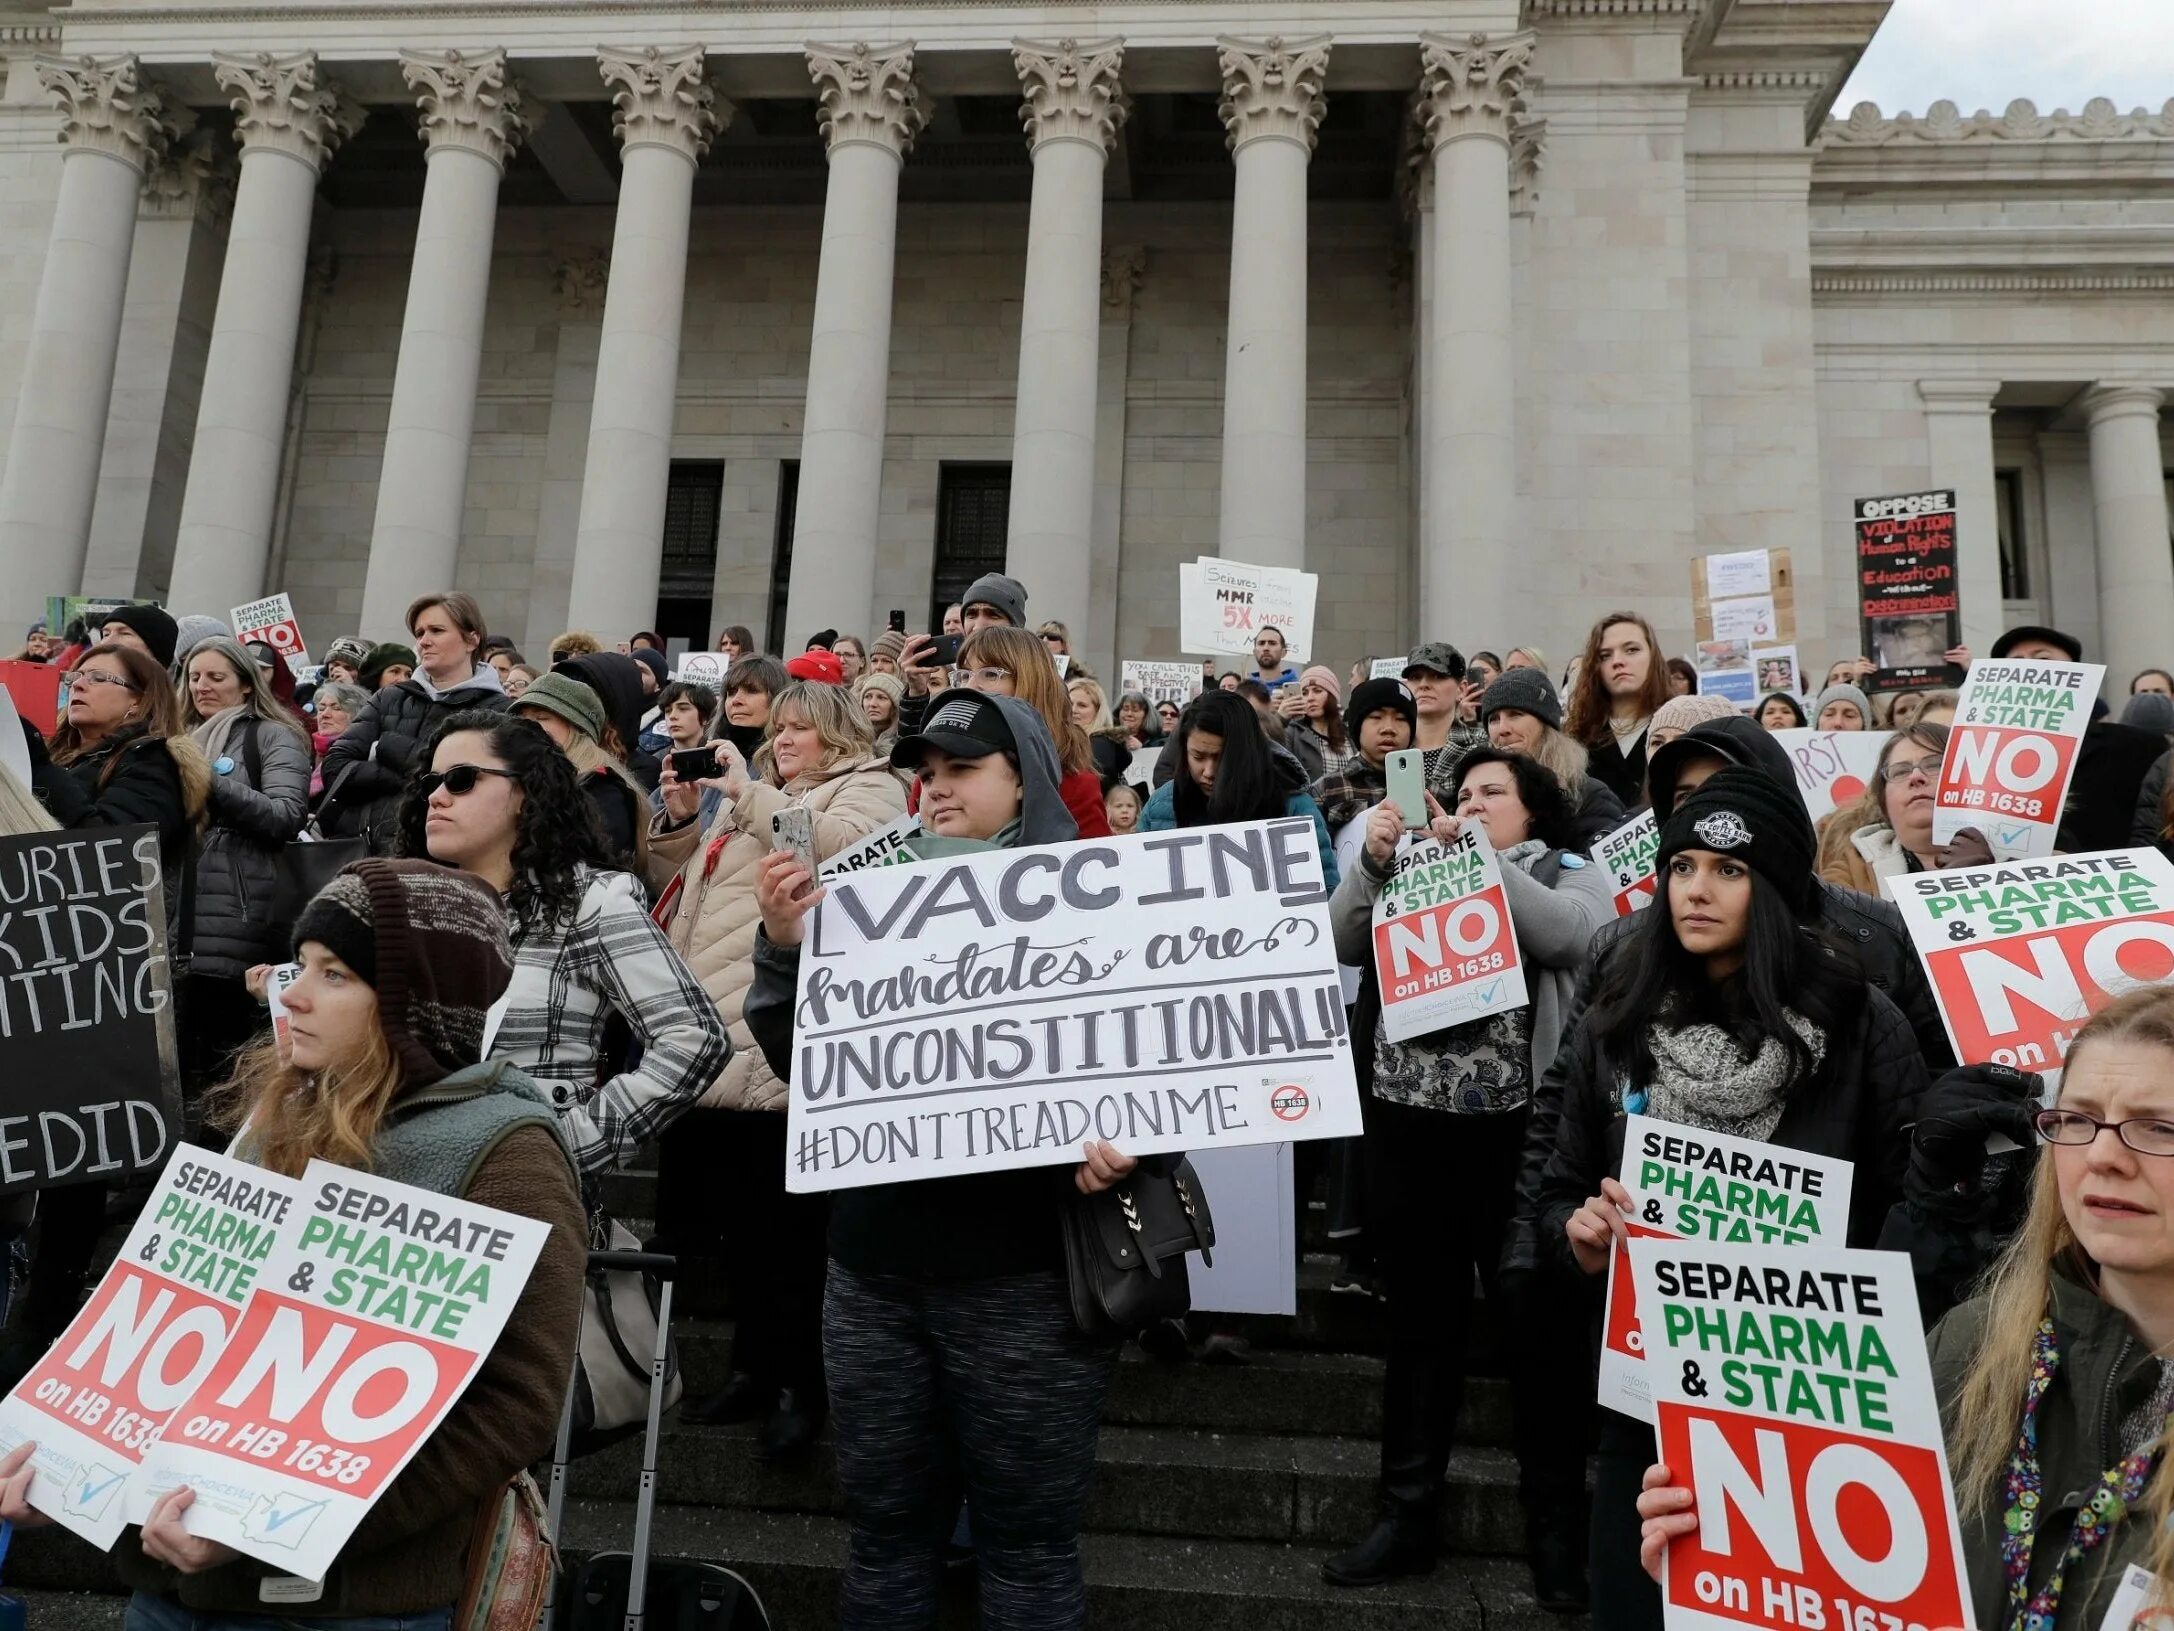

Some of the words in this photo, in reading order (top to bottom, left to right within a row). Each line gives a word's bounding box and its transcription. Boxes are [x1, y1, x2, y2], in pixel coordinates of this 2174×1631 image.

[1862, 493, 1948, 518] OPPOSE
[1863, 514, 1953, 537] VIOLATION
[1860, 539, 1906, 556] Human
[1907, 533, 1951, 556] Rights
[1208, 567, 1257, 589] Seizures
[1217, 589, 1254, 604] MMR
[1863, 564, 1950, 585] Education
[236, 598, 283, 617] SEPARATE
[238, 605, 285, 624] PHARMA
[250, 613, 285, 630] STATE
[1223, 606, 1253, 630] 5X
[1258, 613, 1294, 627] MORE
[244, 624, 295, 648] NO
[1128, 662, 1147, 671] YOU
[1152, 663, 1175, 672] CALL
[1178, 664, 1200, 675] THIS
[1138, 671, 1160, 680] SAFE
[1975, 667, 2084, 689] SEPARATE
[1966, 707, 1978, 722] &
[1982, 705, 2065, 732] STATE
[1969, 685, 2075, 711] PHARMA
[1792, 733, 1848, 790] IRST
[1948, 730, 2059, 793] NO
[1943, 790, 1960, 804] on
[1960, 789, 1985, 806] HB
[1990, 791, 2043, 817] 1638
[1392, 830, 1477, 877] EPARATE
[1602, 816, 1658, 859] SEPAR
[1608, 831, 1660, 875] PHA
[833, 822, 1321, 943] VACCINE
[1382, 849, 1485, 902] PHARMA
[1385, 902, 1398, 918] &
[1404, 870, 1485, 912] STATE
[1620, 873, 1632, 887] &
[1914, 856, 2137, 896] SEPARATE
[1924, 872, 2158, 920] PHARMA
[1388, 898, 1500, 979] NO
[1948, 920, 1976, 942] &
[1987, 891, 2160, 935] STATE
[796, 936, 1132, 1028] mandates
[1145, 922, 1280, 969] are
[1394, 982, 1420, 998] on
[1424, 967, 1453, 990] HB
[1457, 952, 1504, 979] 1638
[1958, 920, 2174, 1037] NO
[1990, 1042, 2046, 1067] on
[1274, 1100, 1286, 1108] HB
[1287, 1098, 1306, 1107] 1638
[1642, 1132, 1824, 1198] SEPARATE
[173, 1161, 294, 1226] SEPARATE
[1640, 1160, 1822, 1235] PHARMA
[1642, 1199, 1664, 1225] &
[153, 1192, 277, 1262] PHARMA
[313, 1182, 515, 1262] SEPARATE
[139, 1233, 161, 1262] &
[159, 1238, 258, 1303] STATE
[297, 1215, 491, 1304] PHARMA
[288, 1261, 315, 1294] &
[323, 1268, 472, 1340] STATE
[1655, 1260, 1884, 1317] SEPARATE
[64, 1273, 227, 1412] NO
[1626, 1331, 1644, 1351] o
[1663, 1304, 1899, 1378] PHARMA
[216, 1305, 439, 1444] NO
[1681, 1359, 1709, 1398] &
[1721, 1359, 1894, 1434] STATE
[35, 1378, 72, 1409] on
[65, 1387, 111, 1426] HB
[102, 1406, 164, 1456] 1638
[183, 1415, 231, 1444] on
[226, 1422, 288, 1458] HB
[282, 1439, 372, 1485] 1638
[1688, 1416, 1929, 1603] NO
[1694, 1571, 1749, 1613] on
[1762, 1576, 1826, 1631] HB
[1834, 1598, 1932, 1631] 16
